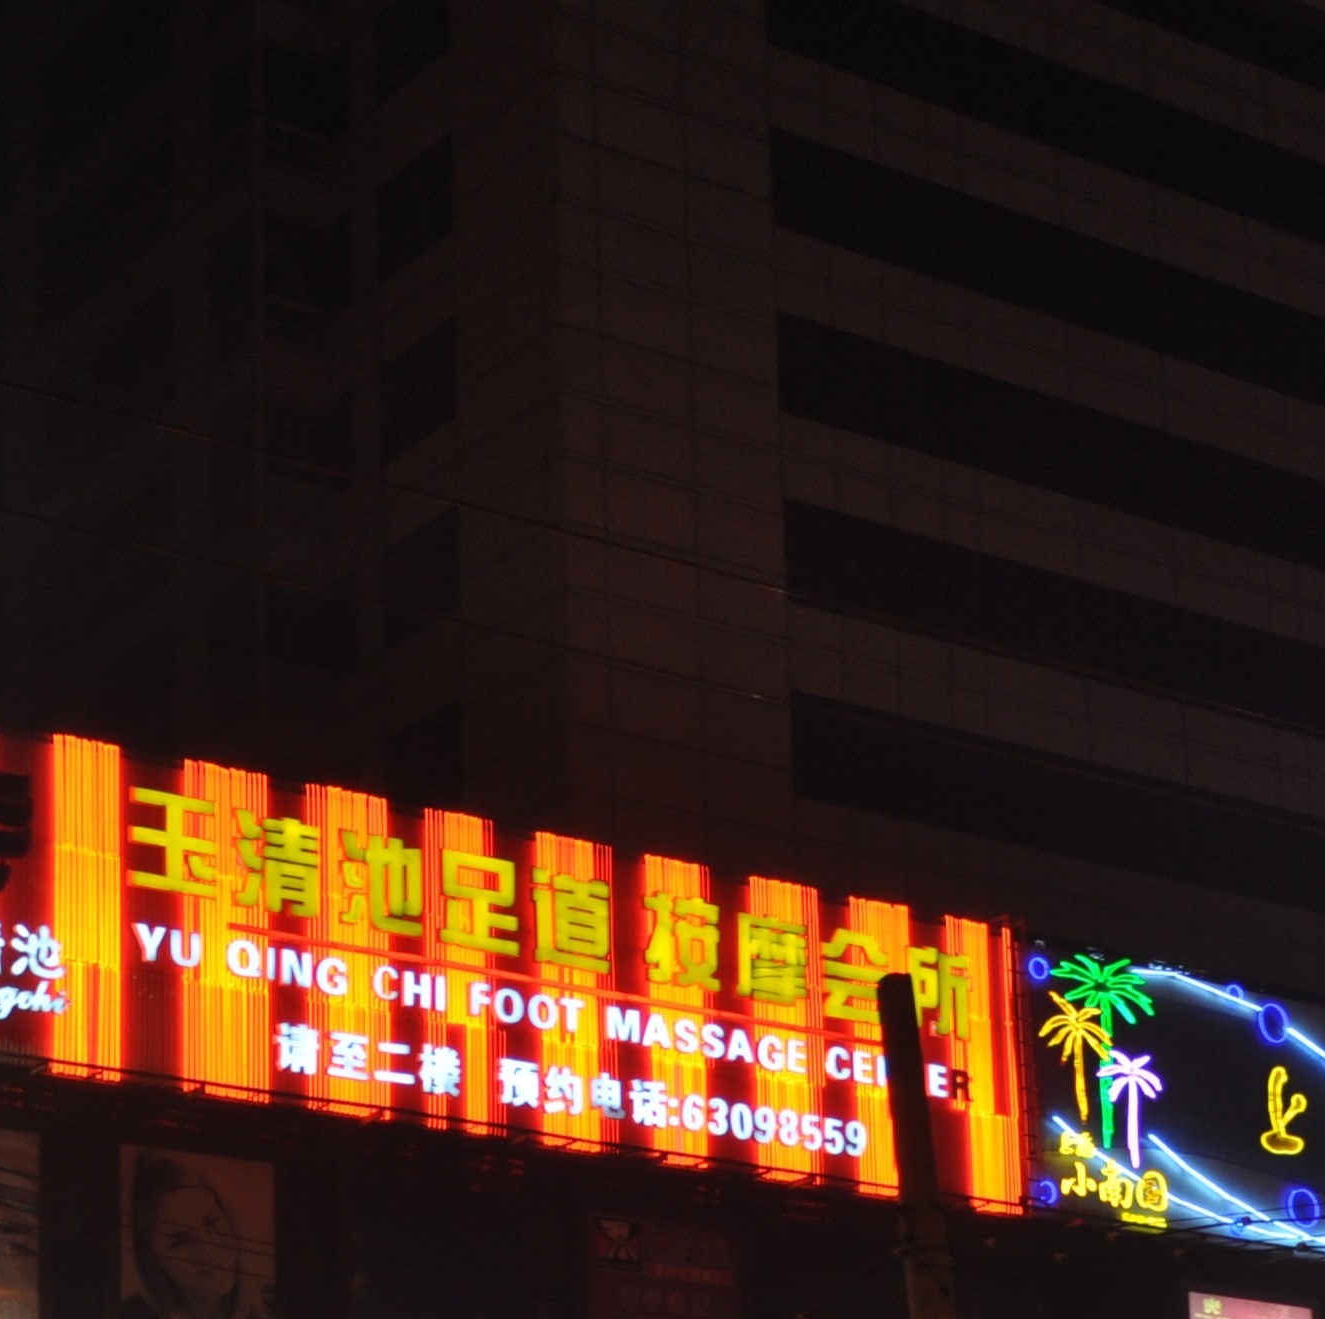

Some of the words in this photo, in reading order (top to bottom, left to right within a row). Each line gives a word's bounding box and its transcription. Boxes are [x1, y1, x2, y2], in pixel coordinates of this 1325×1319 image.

[126, 786, 970, 1041] 玉清池足道按摩会所
[132, 922, 201, 968] YU
[227, 938, 349, 997] QING
[372, 965, 447, 1013] CHI
[469, 981, 585, 1034] FOOT
[605, 1005, 808, 1076] MASSAGE
[825, 1046, 973, 1103] CEER
[275, 1021, 462, 1099] 请至二楼
[498, 1056, 868, 1158] 预约电话:63098559
